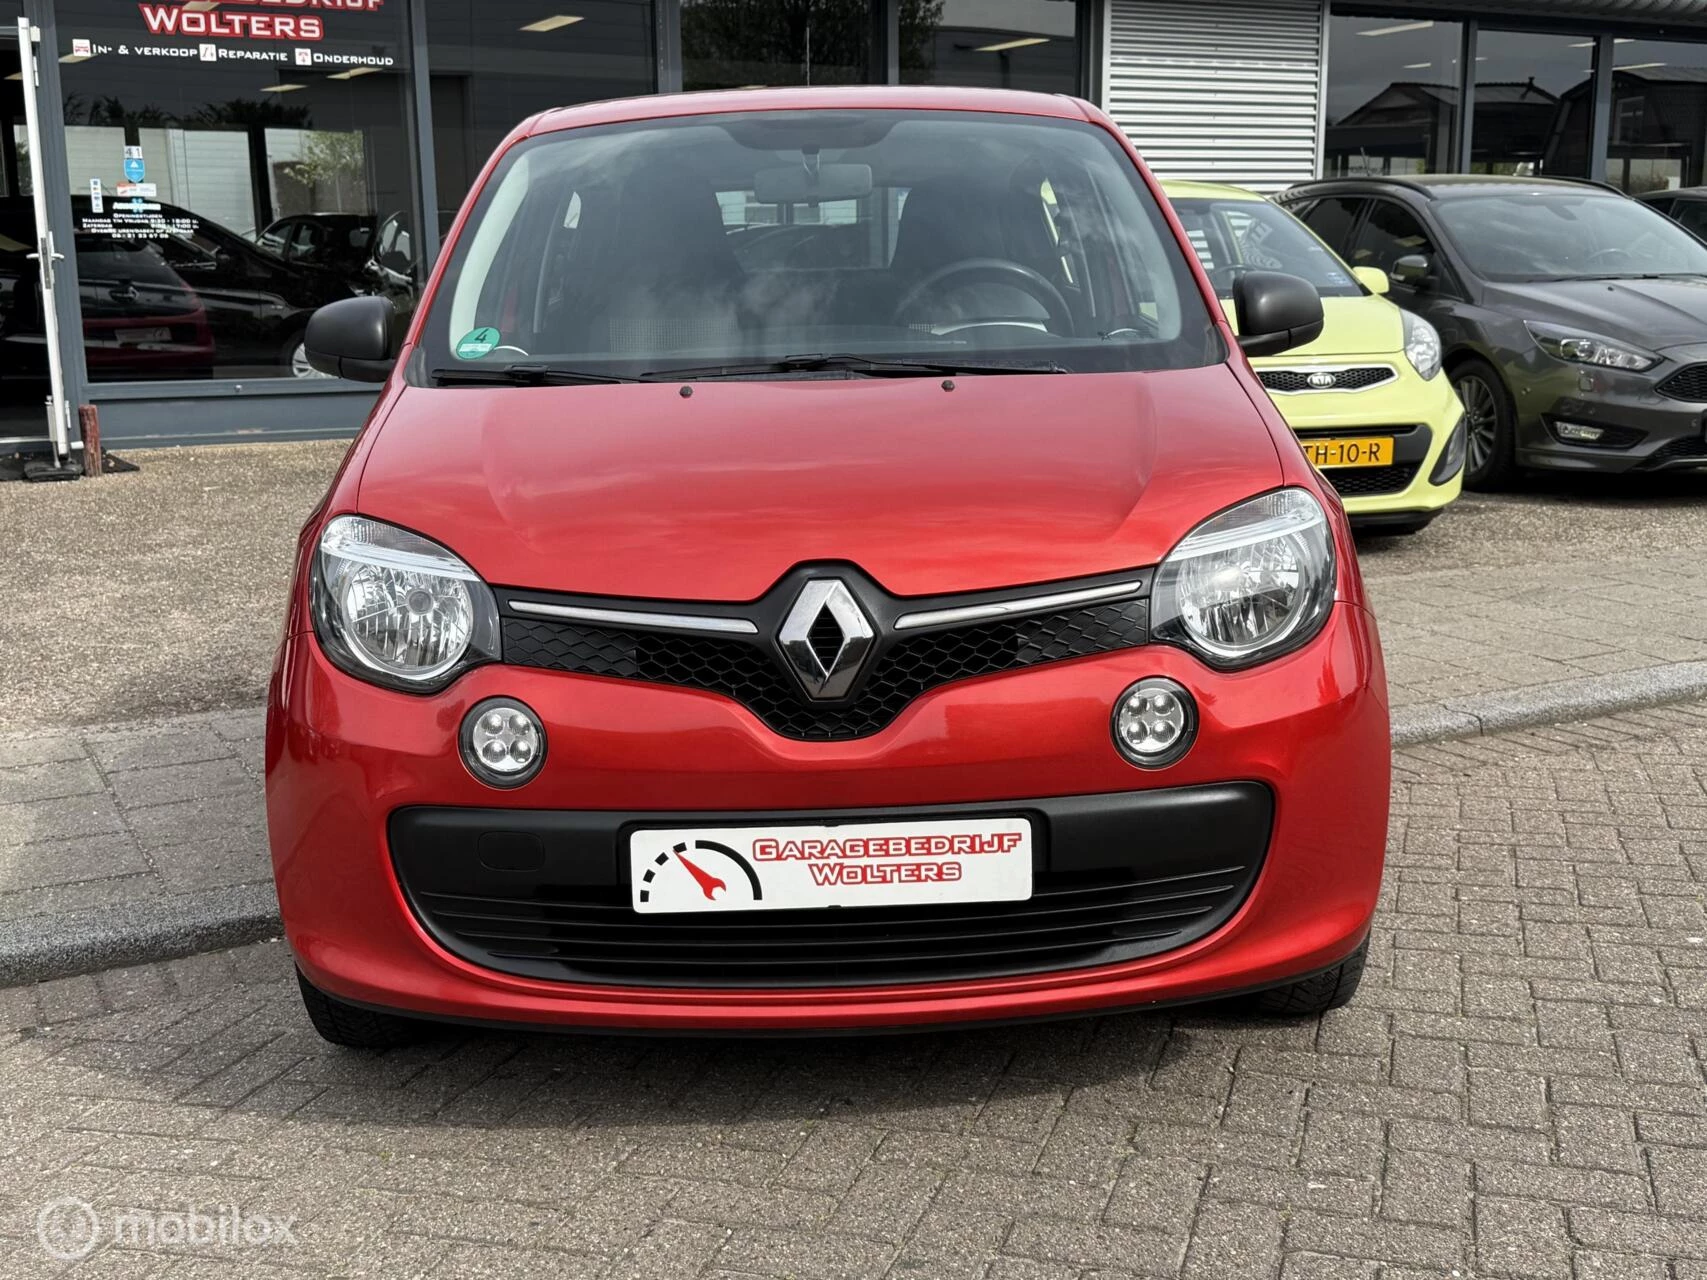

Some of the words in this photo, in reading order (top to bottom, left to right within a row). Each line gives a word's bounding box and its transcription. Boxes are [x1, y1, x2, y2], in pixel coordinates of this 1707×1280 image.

[139, 4, 323, 40] WOLTERS
[118, 44, 129, 55] &
[474, 327, 489, 343] 4
[752, 832, 1022, 862] GARAGEBEDRIJF
[808, 861, 962, 886] WOLTERS
